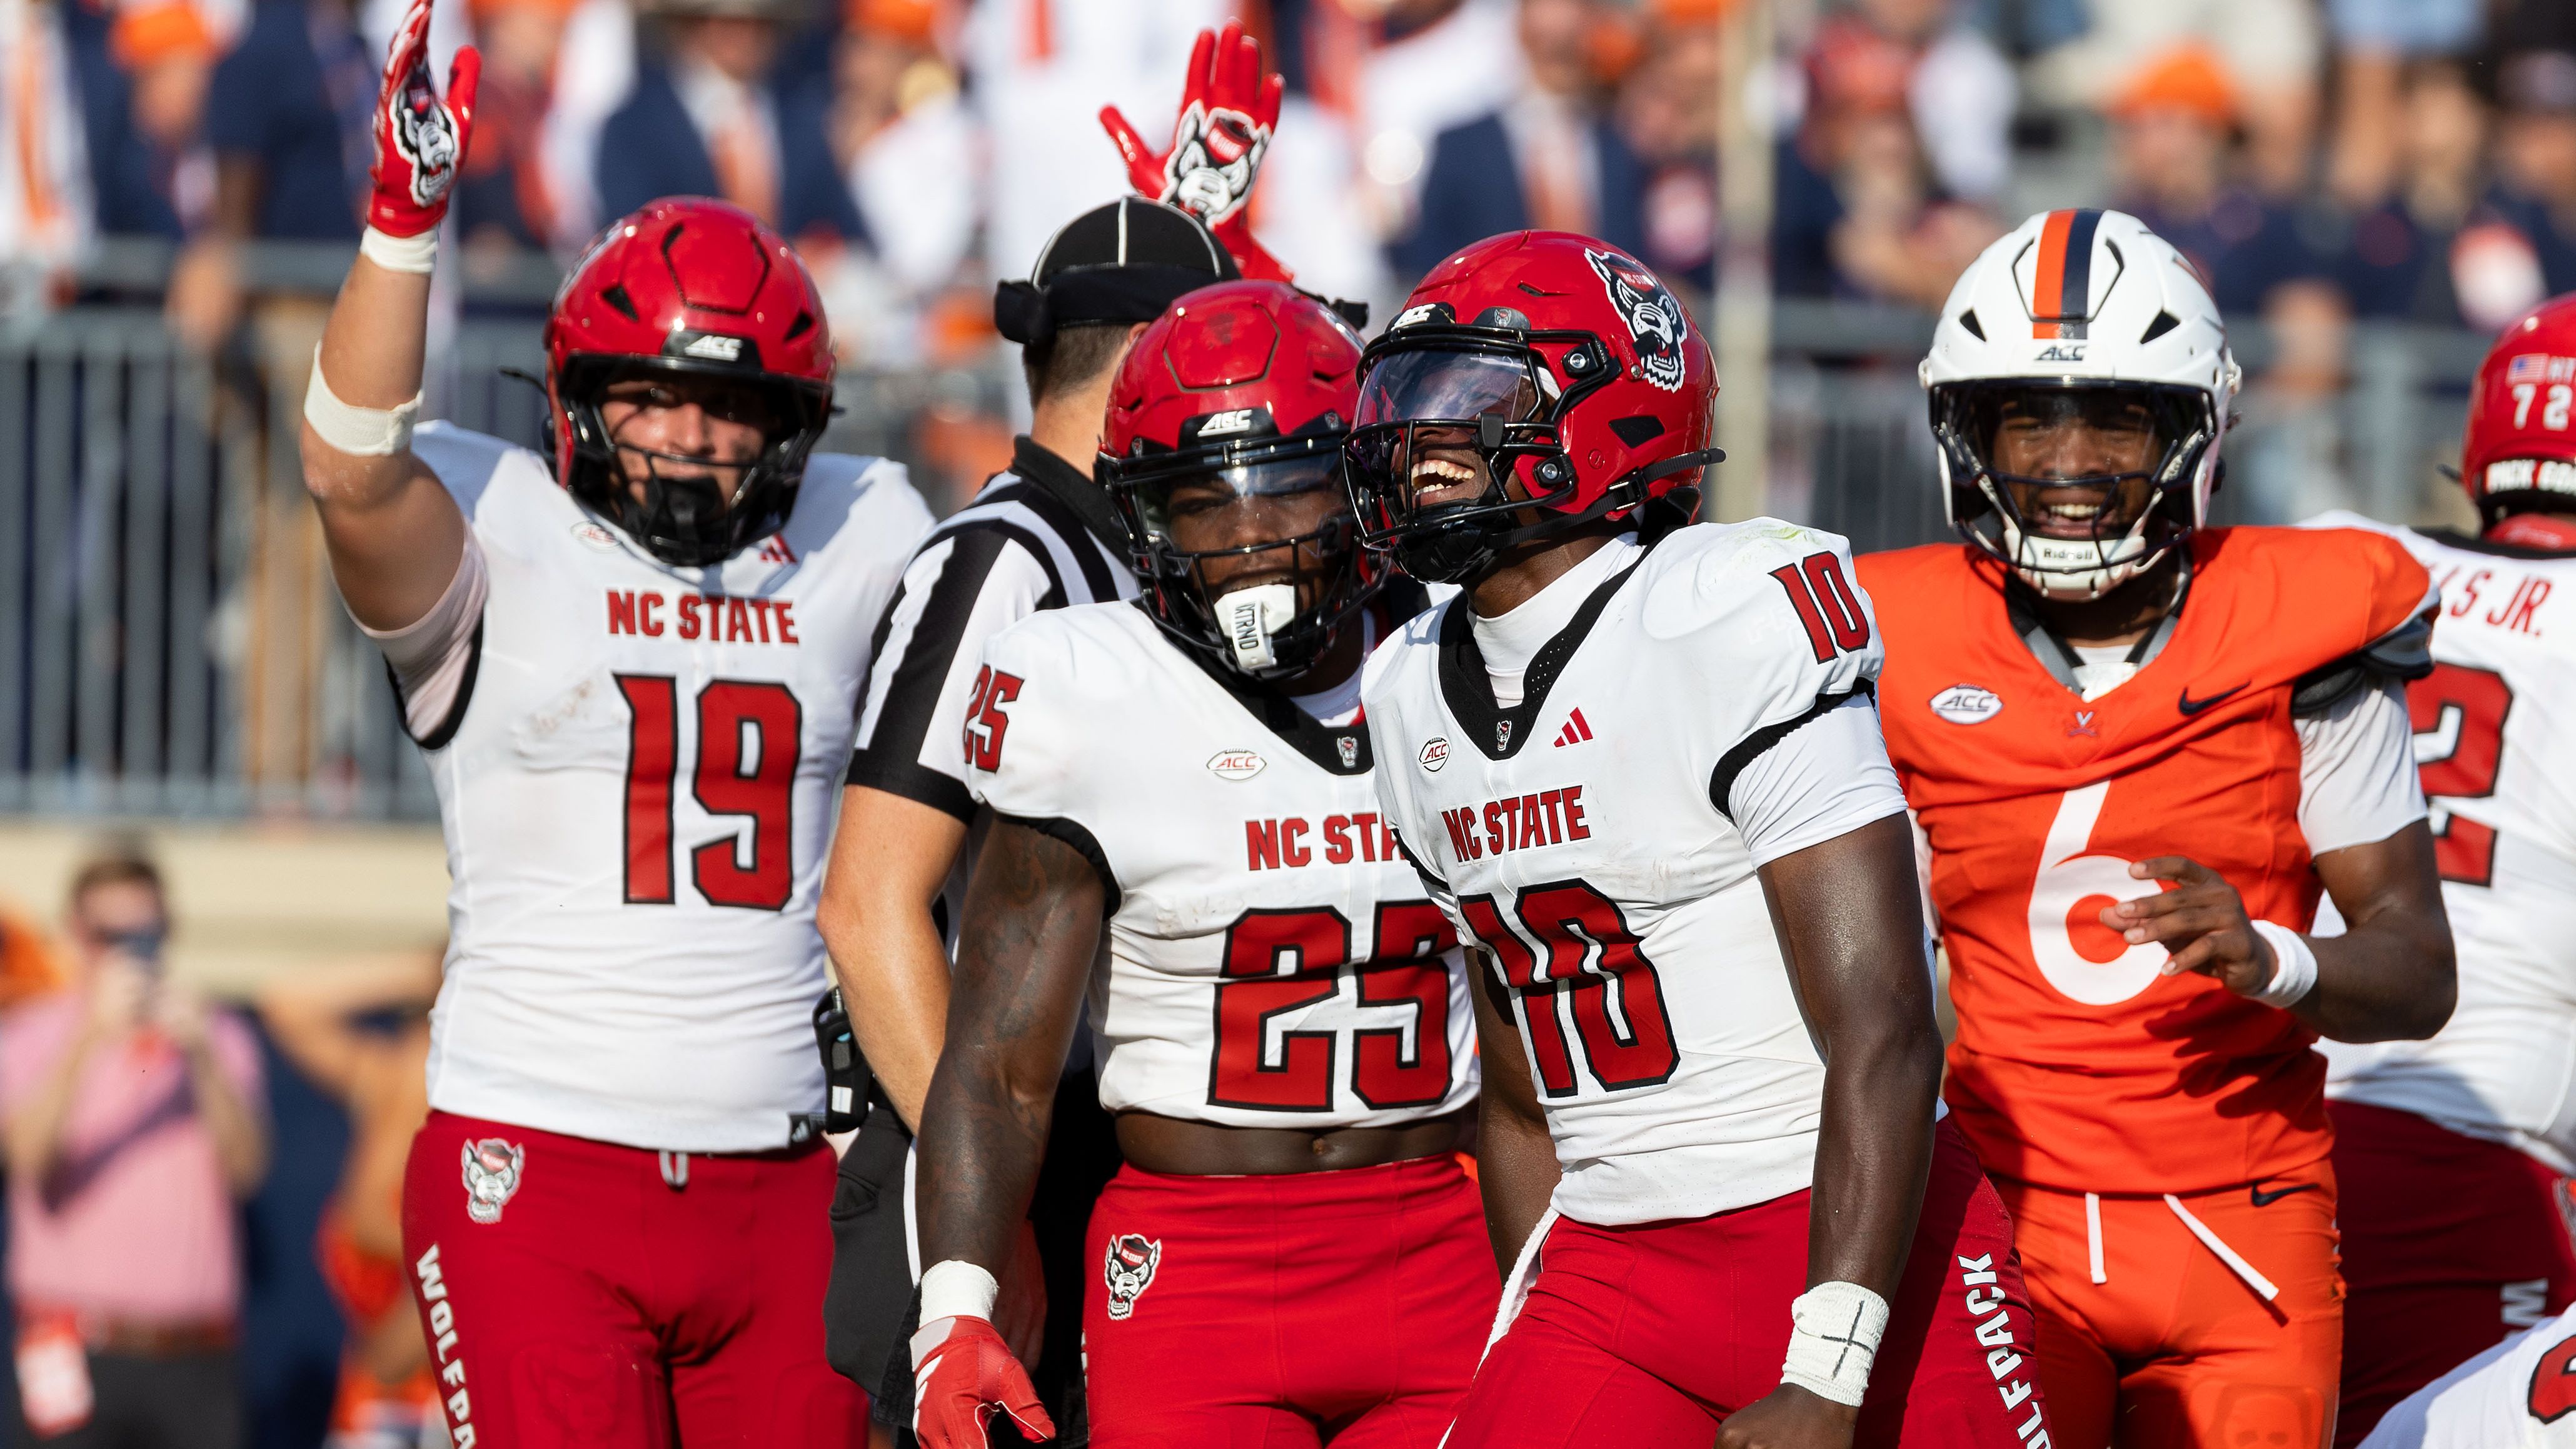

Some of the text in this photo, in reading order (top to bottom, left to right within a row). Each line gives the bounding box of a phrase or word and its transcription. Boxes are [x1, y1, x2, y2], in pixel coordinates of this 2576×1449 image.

[686, 334, 742, 359] ACC
[2036, 344, 2087, 360] ACC
[1199, 409, 1252, 434] ACC
[2512, 383, 2573, 432] 72
[2044, 548, 2093, 559] Ridell
[607, 590, 799, 644] NC STATE
[1769, 551, 1869, 664] 10
[2486, 575, 2553, 636] JR.
[962, 663, 1025, 774] 25
[1941, 693, 1995, 711] ACC
[1215, 755, 1258, 769] ACC
[1424, 743, 1447, 761] ACC
[612, 673, 802, 911] 19
[1245, 818, 1312, 871] NC
[1441, 785, 1591, 863] NC STATE
[2027, 778, 2171, 1005] 6
[1207, 899, 1459, 1112] 25
[1456, 878, 1680, 1097] 10
